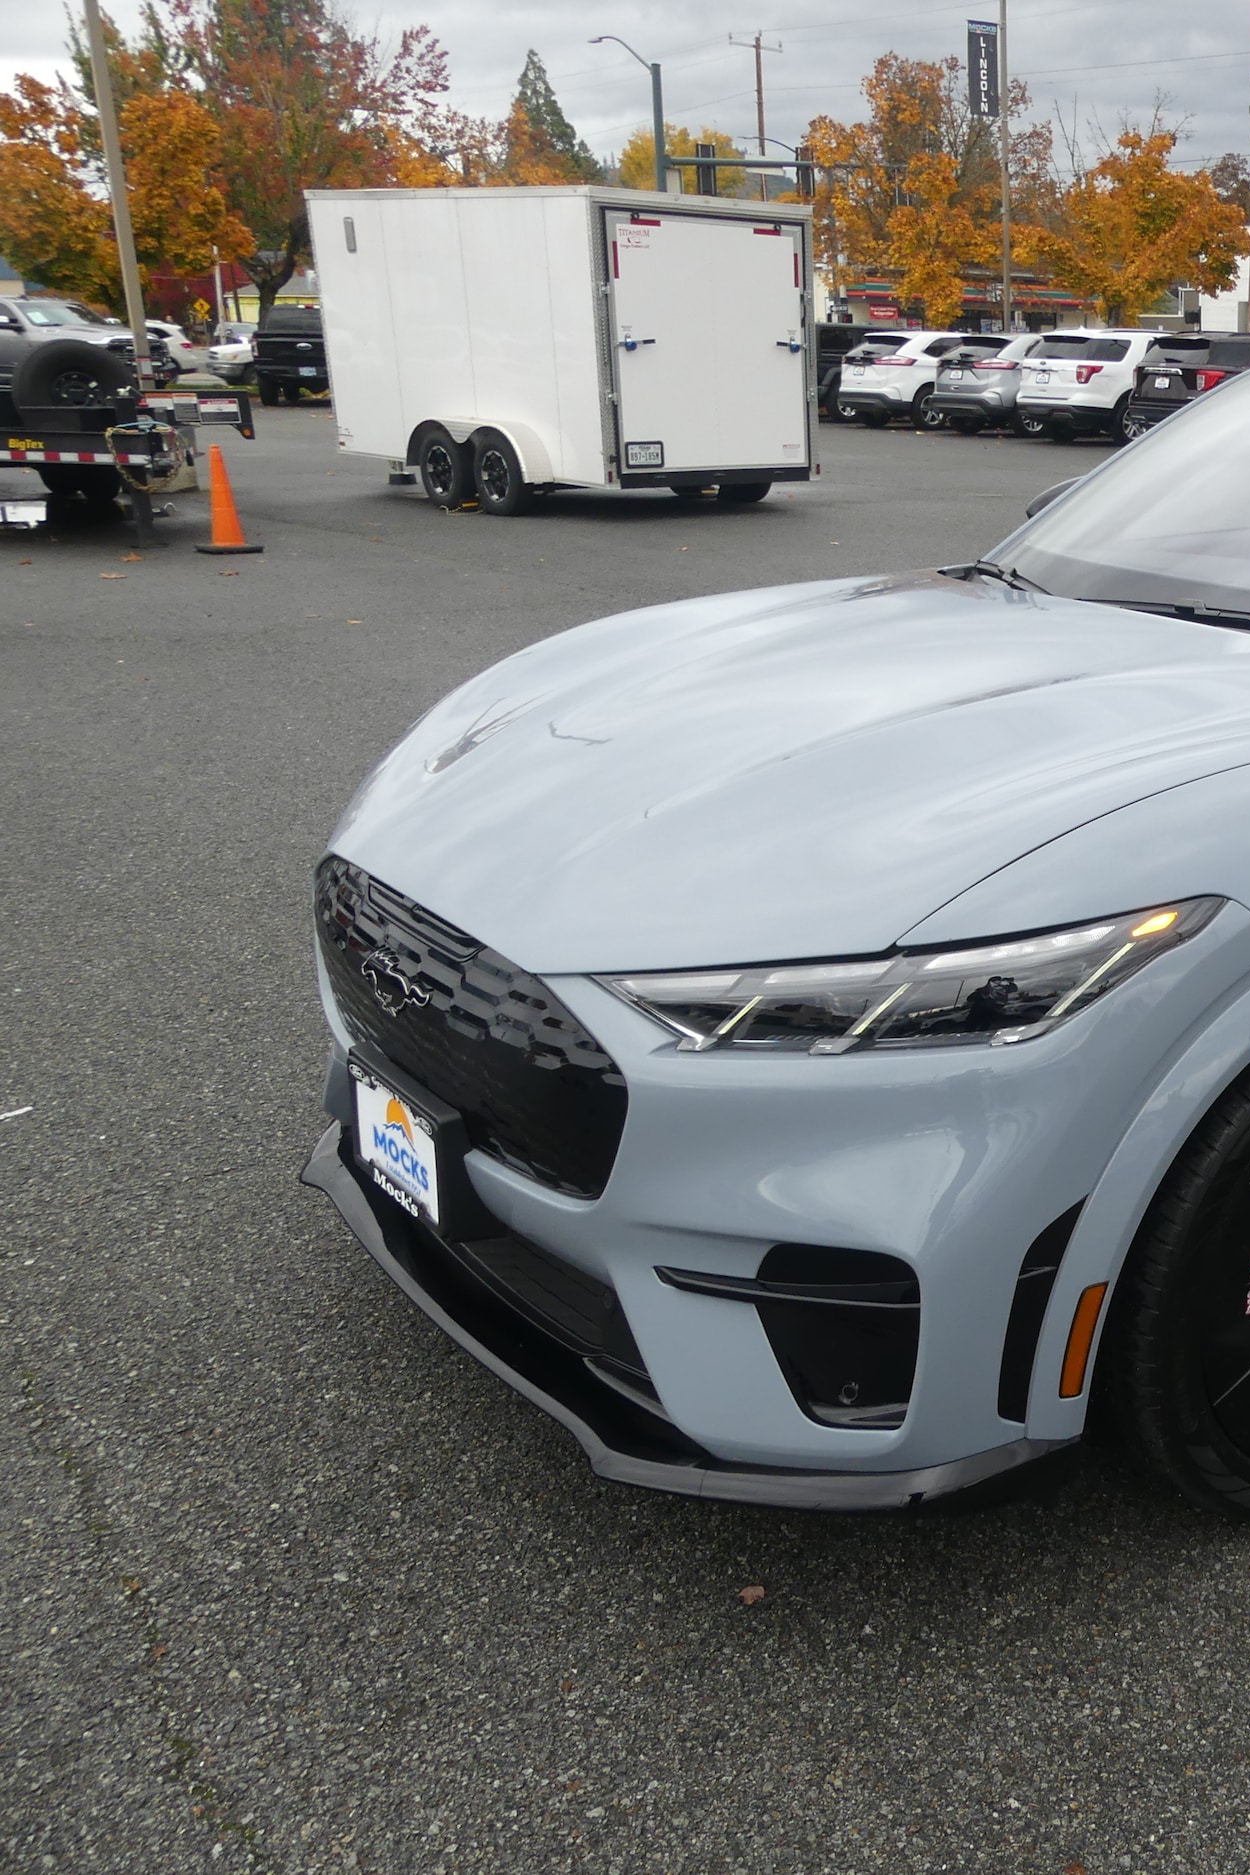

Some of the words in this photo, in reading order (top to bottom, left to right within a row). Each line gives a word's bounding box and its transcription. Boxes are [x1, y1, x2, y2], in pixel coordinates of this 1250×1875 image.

[980, 36, 989, 113] LINCOLN
[618, 229, 650, 237] TITANIUM
[374, 1124, 429, 1192] MOCKS
[373, 1167, 419, 1218] Mock's
